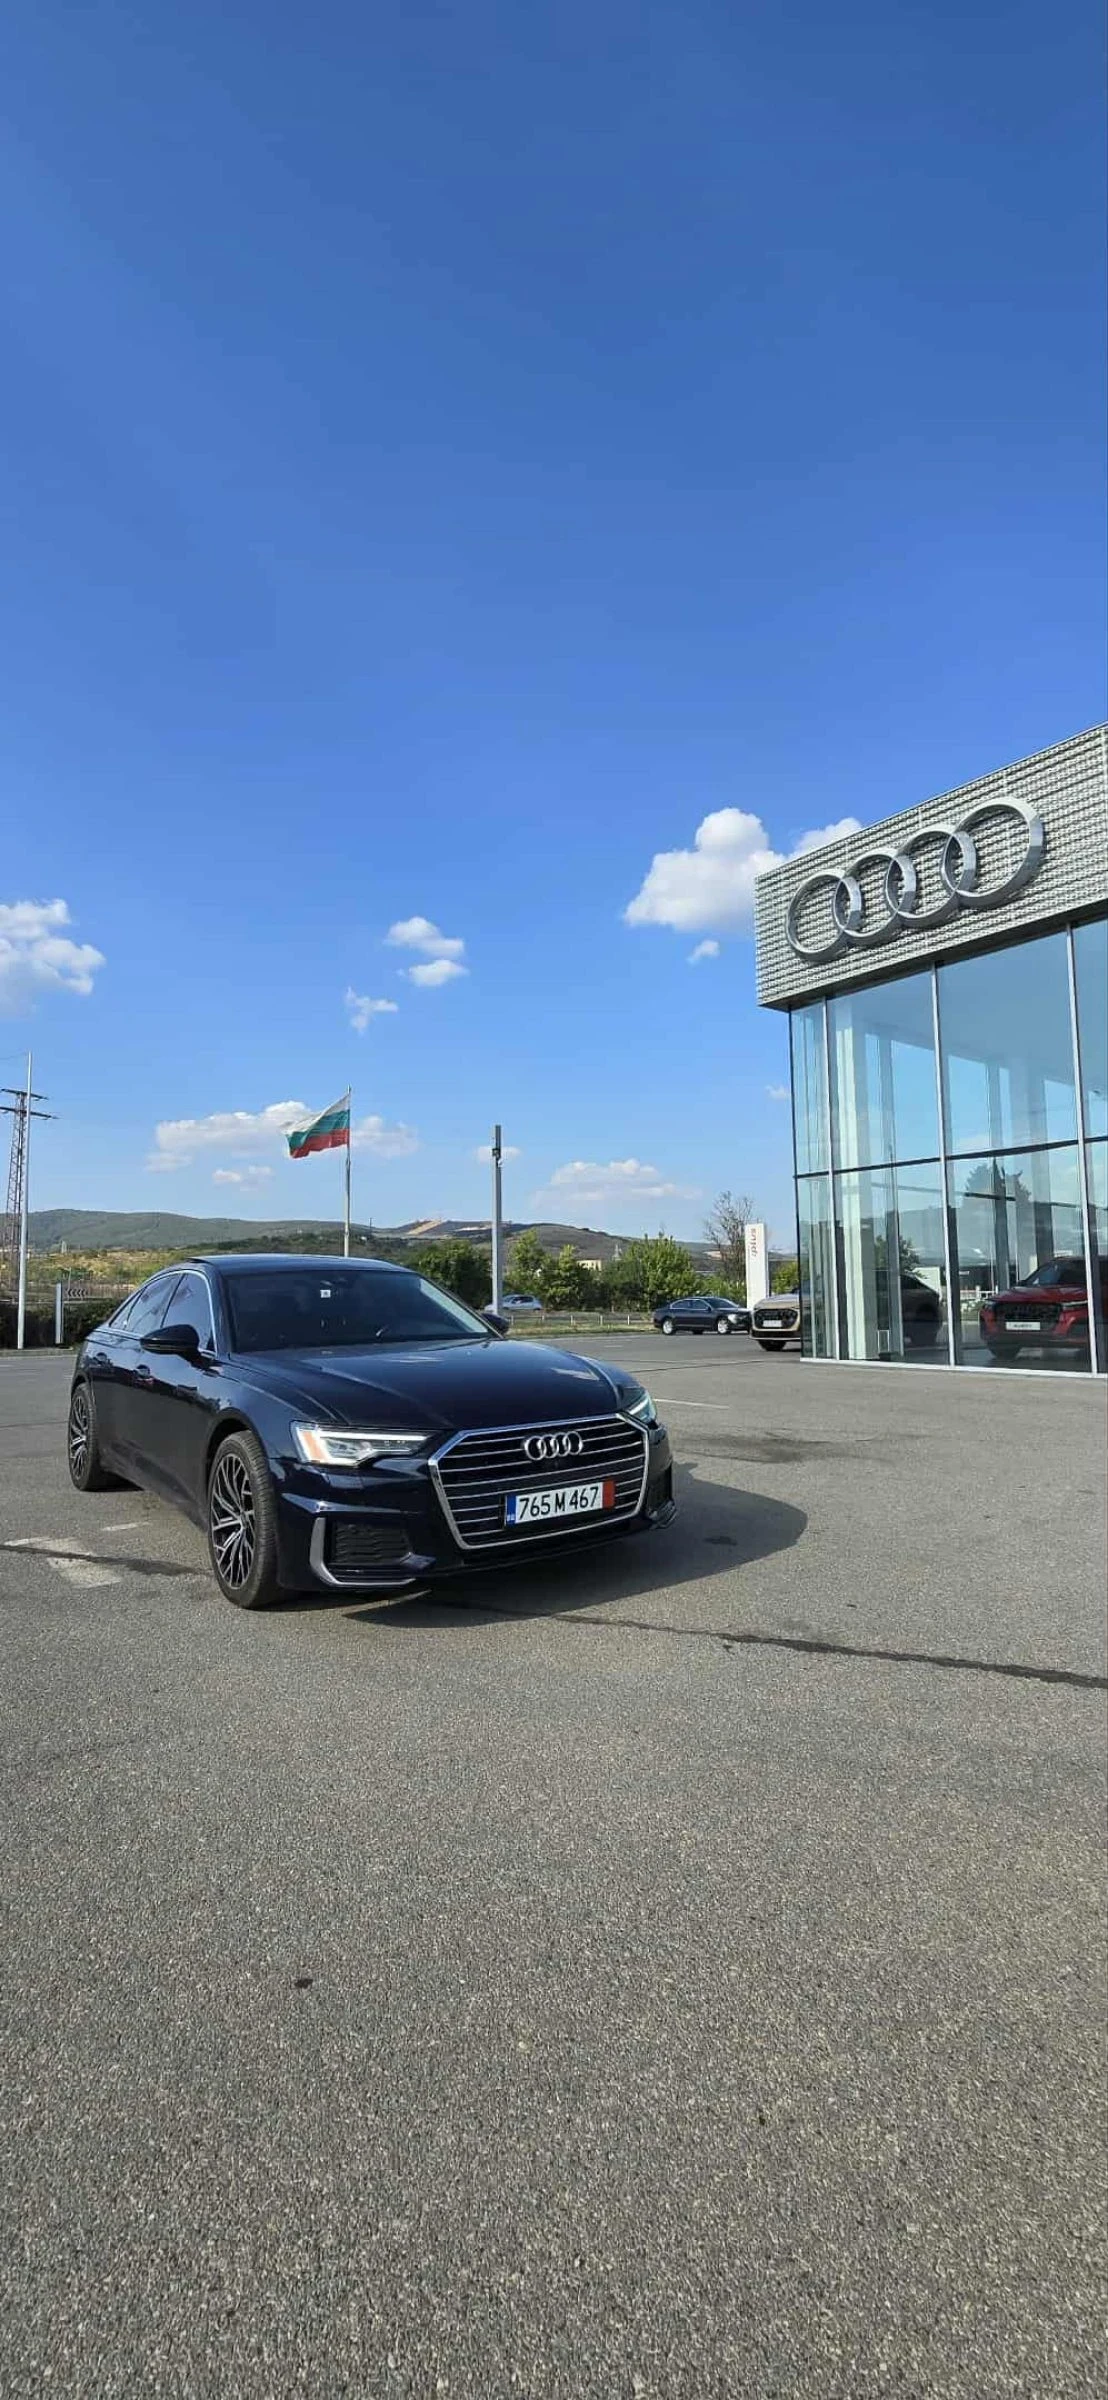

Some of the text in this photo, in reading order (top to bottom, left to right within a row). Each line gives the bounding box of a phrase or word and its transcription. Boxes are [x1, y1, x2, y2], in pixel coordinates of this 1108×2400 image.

[519, 1486, 599, 1519] 765 M 467
